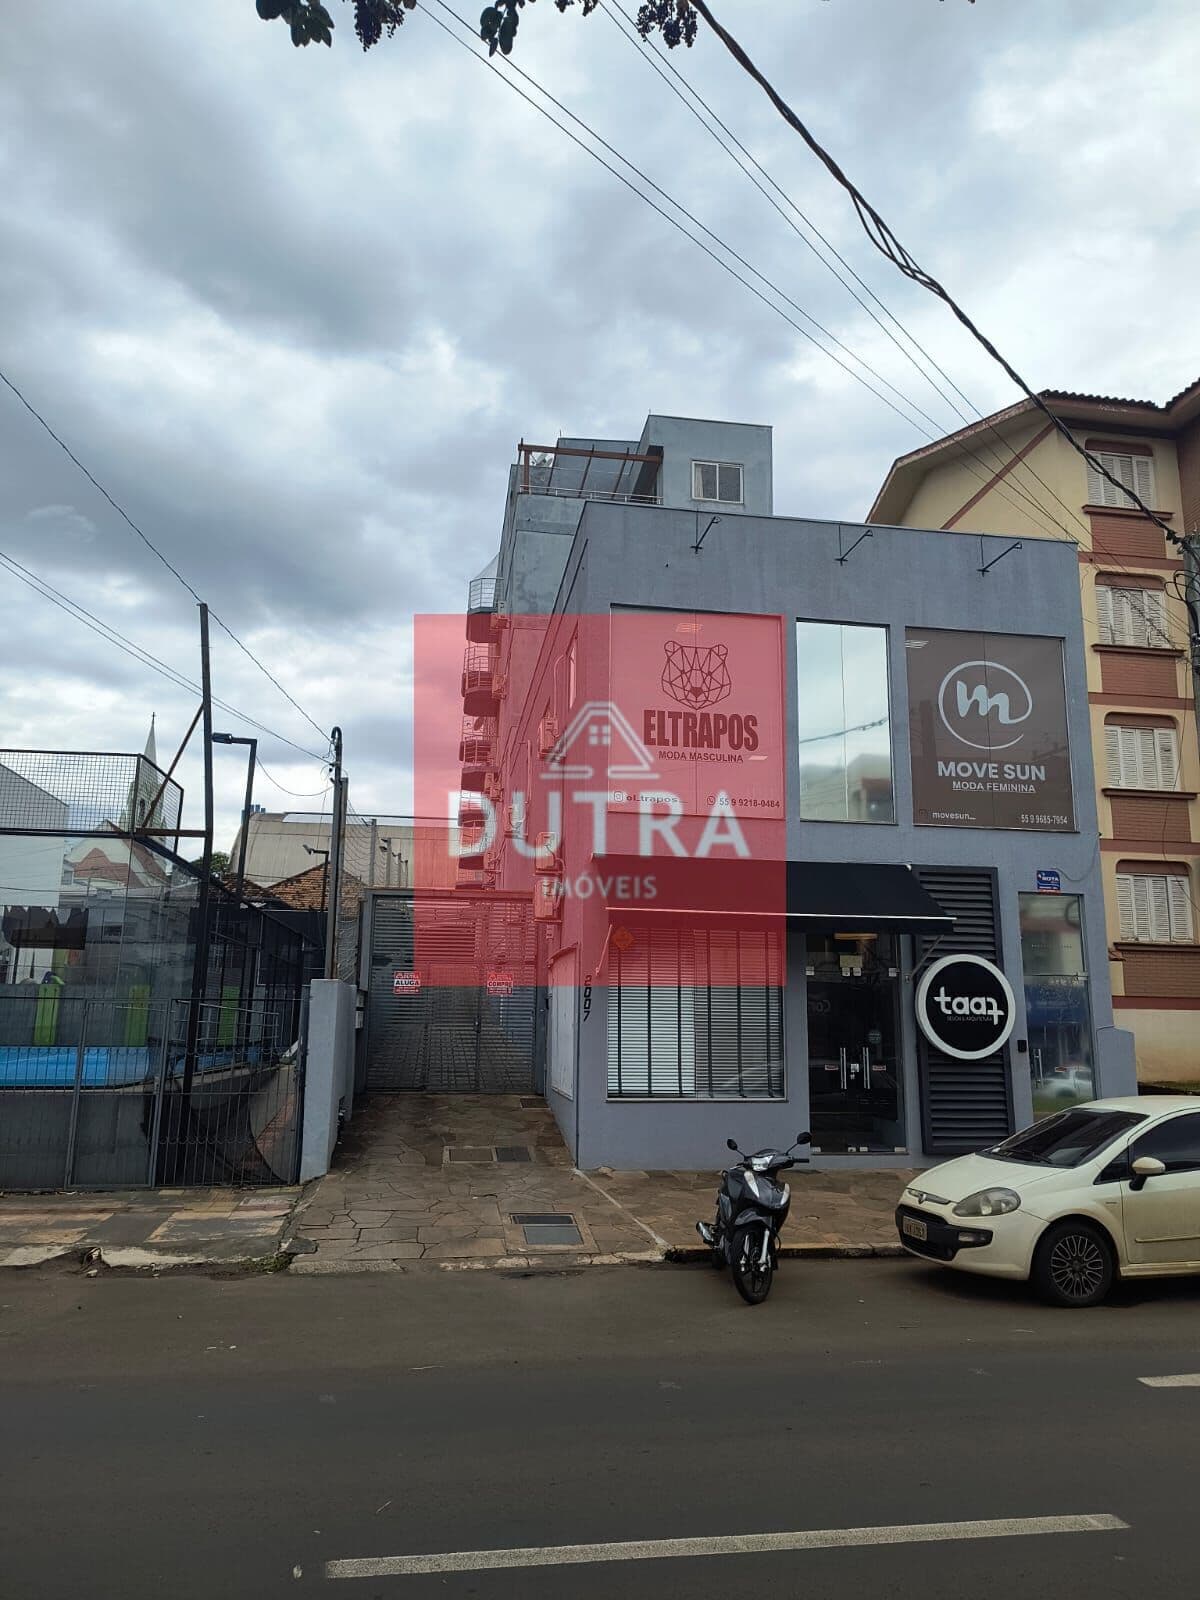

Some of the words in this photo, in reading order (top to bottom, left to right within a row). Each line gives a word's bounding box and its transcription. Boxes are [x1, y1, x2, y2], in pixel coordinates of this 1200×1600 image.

[643, 709, 759, 751] ELTRAPOS
[658, 750, 687, 760] MODA
[689, 752, 744, 763] MASCULINA
[937, 761, 999, 779] MOVE
[1004, 764, 1046, 781] SUN
[952, 780, 985, 790] MODA
[986, 783, 1036, 793] FEMININA
[719, 798, 730, 806] 55
[731, 798, 738, 806] 9
[1021, 814, 1029, 823] 55
[583, 974, 592, 1022] 2007
